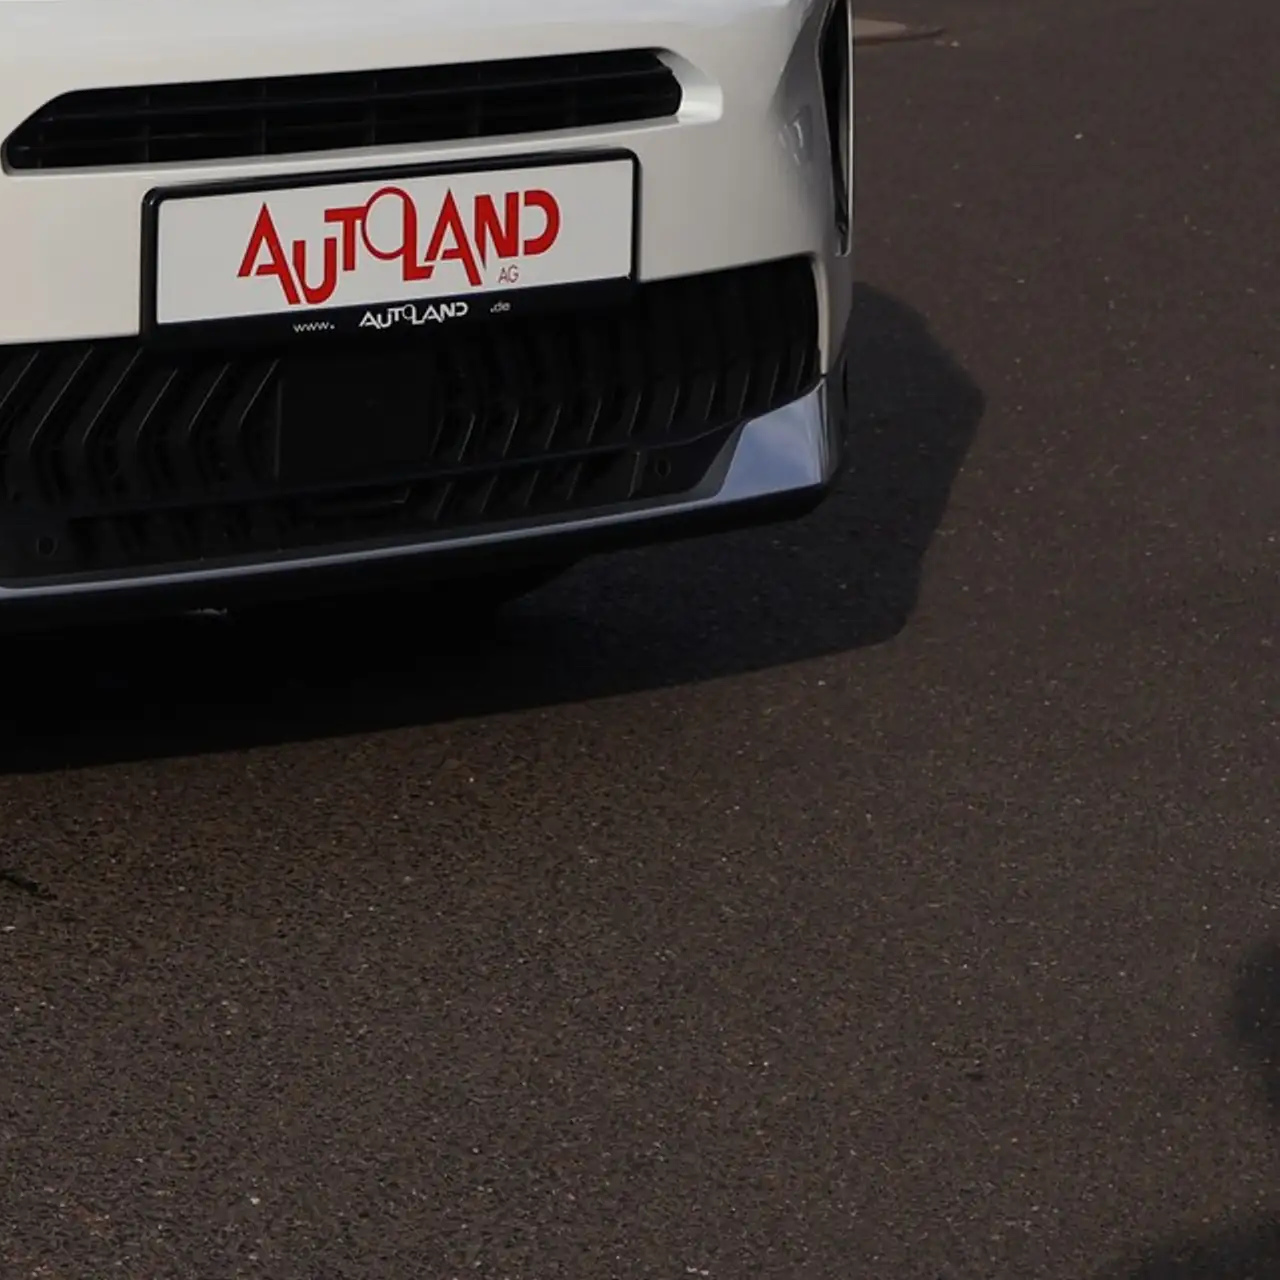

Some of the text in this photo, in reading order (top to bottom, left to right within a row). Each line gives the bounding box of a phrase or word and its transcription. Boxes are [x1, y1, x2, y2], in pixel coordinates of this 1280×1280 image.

[237, 186, 561, 305] AUTOLAND
[497, 265, 519, 284] AG
[358, 302, 469, 330] AUTOLAND
